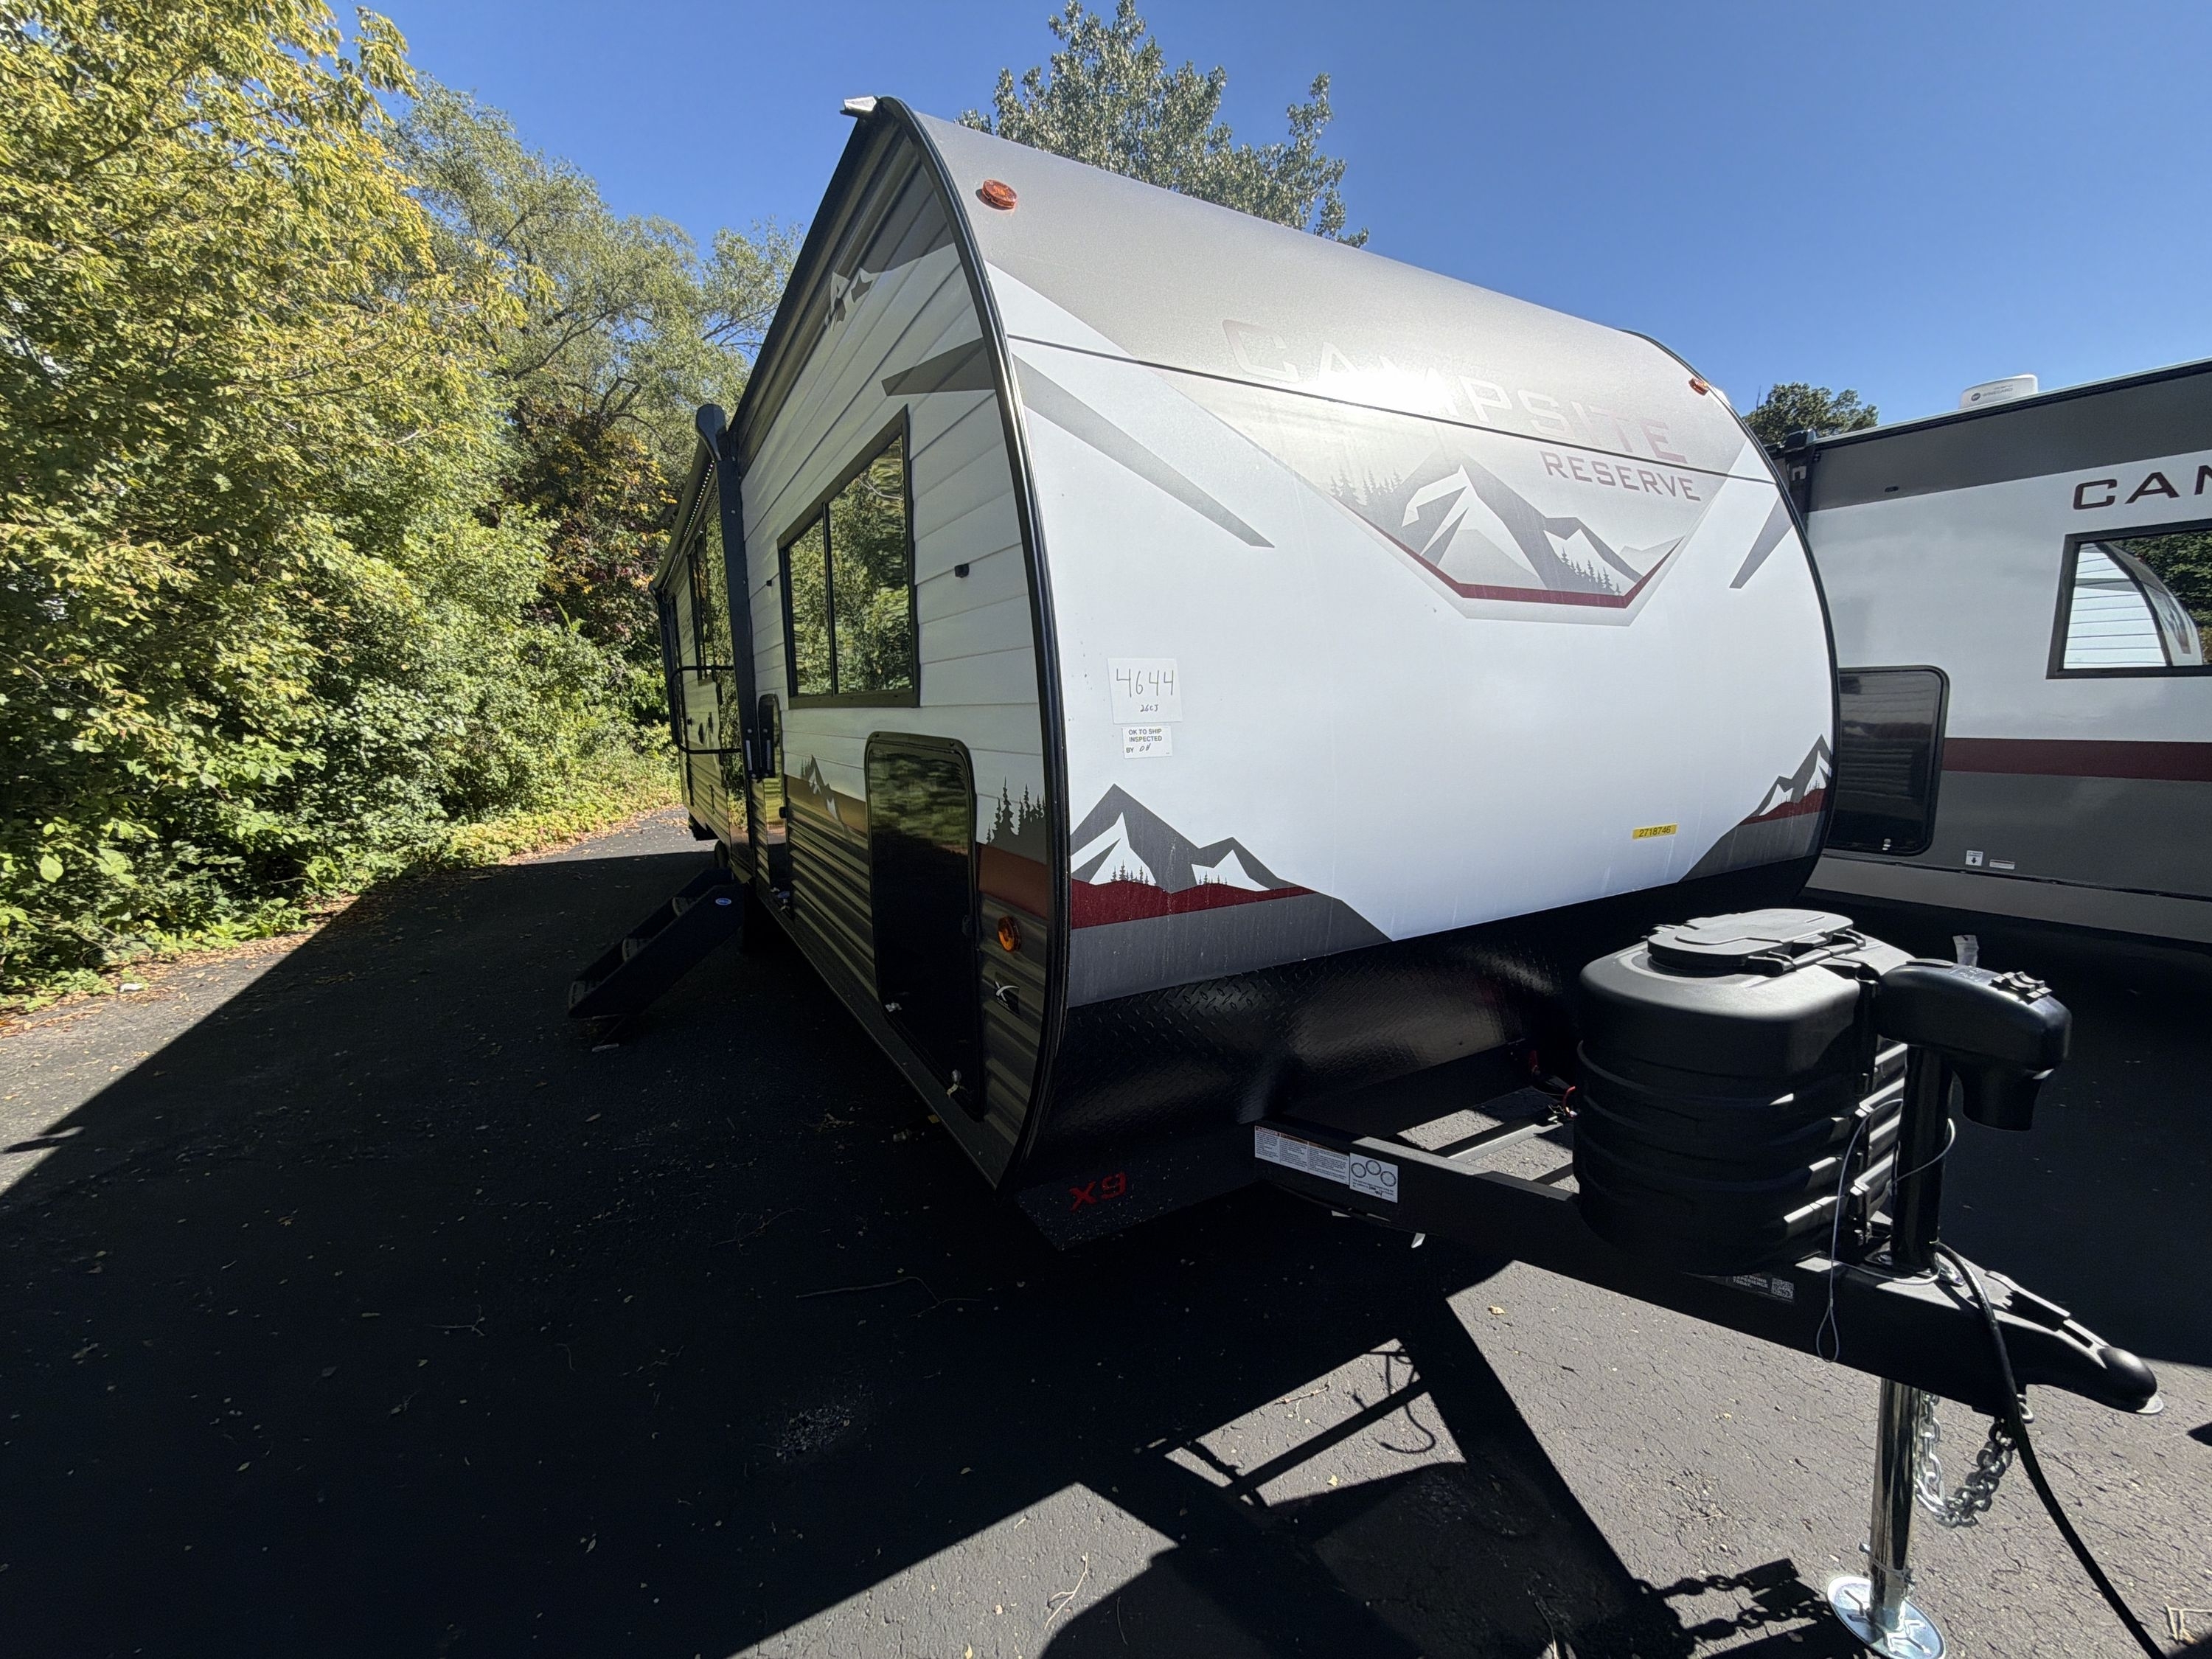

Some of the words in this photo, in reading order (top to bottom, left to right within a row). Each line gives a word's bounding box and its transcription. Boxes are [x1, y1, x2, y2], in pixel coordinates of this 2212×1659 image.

[1540, 451, 1701, 501] RESERVE
[1116, 668, 1174, 698] 4644
[1069, 1171, 1127, 1212] X9
